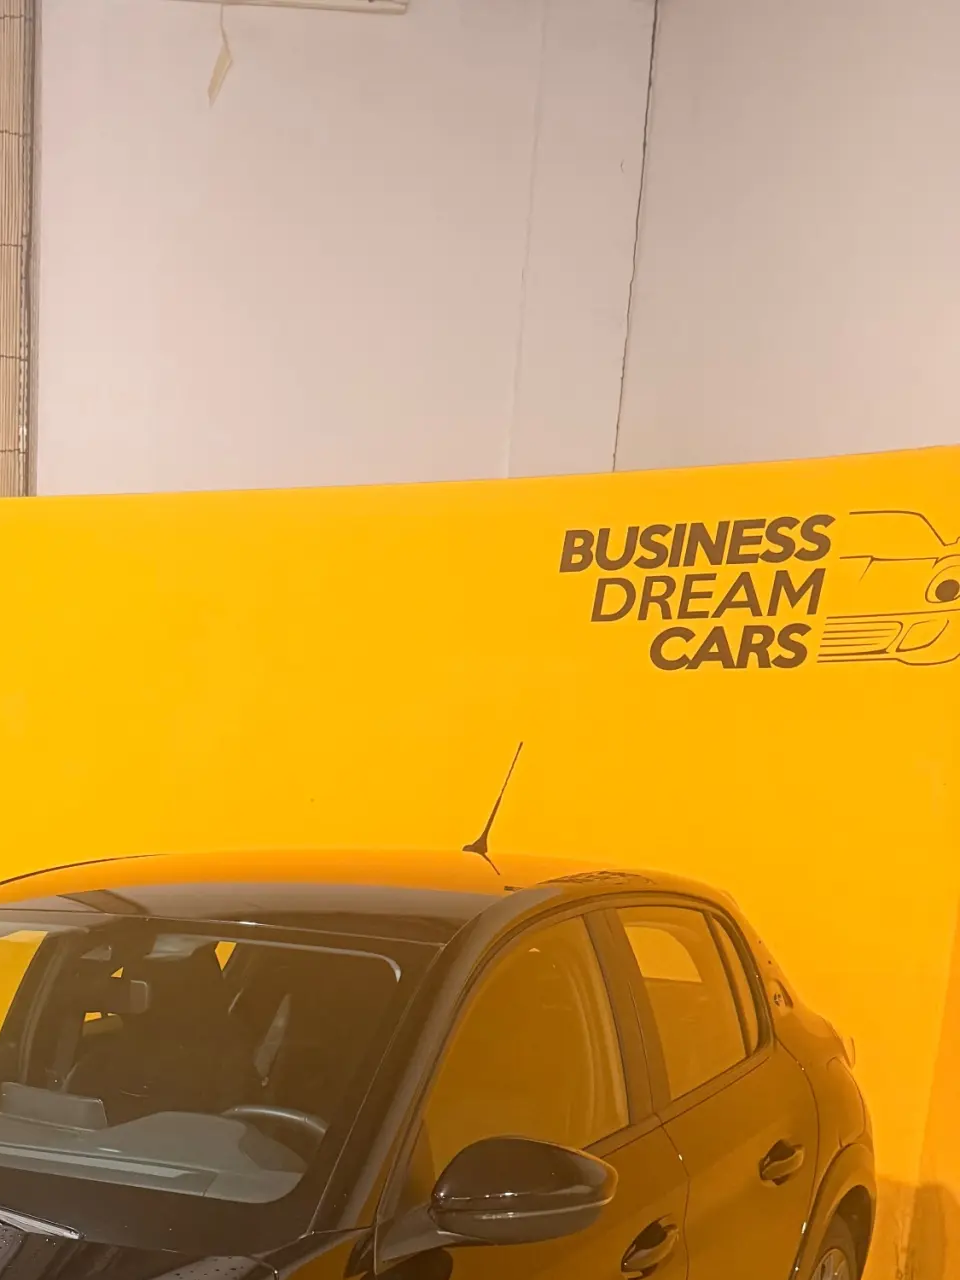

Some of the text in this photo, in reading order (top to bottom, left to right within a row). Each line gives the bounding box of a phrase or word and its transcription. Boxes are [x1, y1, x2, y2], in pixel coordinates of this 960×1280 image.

[558, 514, 836, 573] BUSINESS
[590, 568, 826, 623] DREAM
[649, 623, 812, 671] CARS
